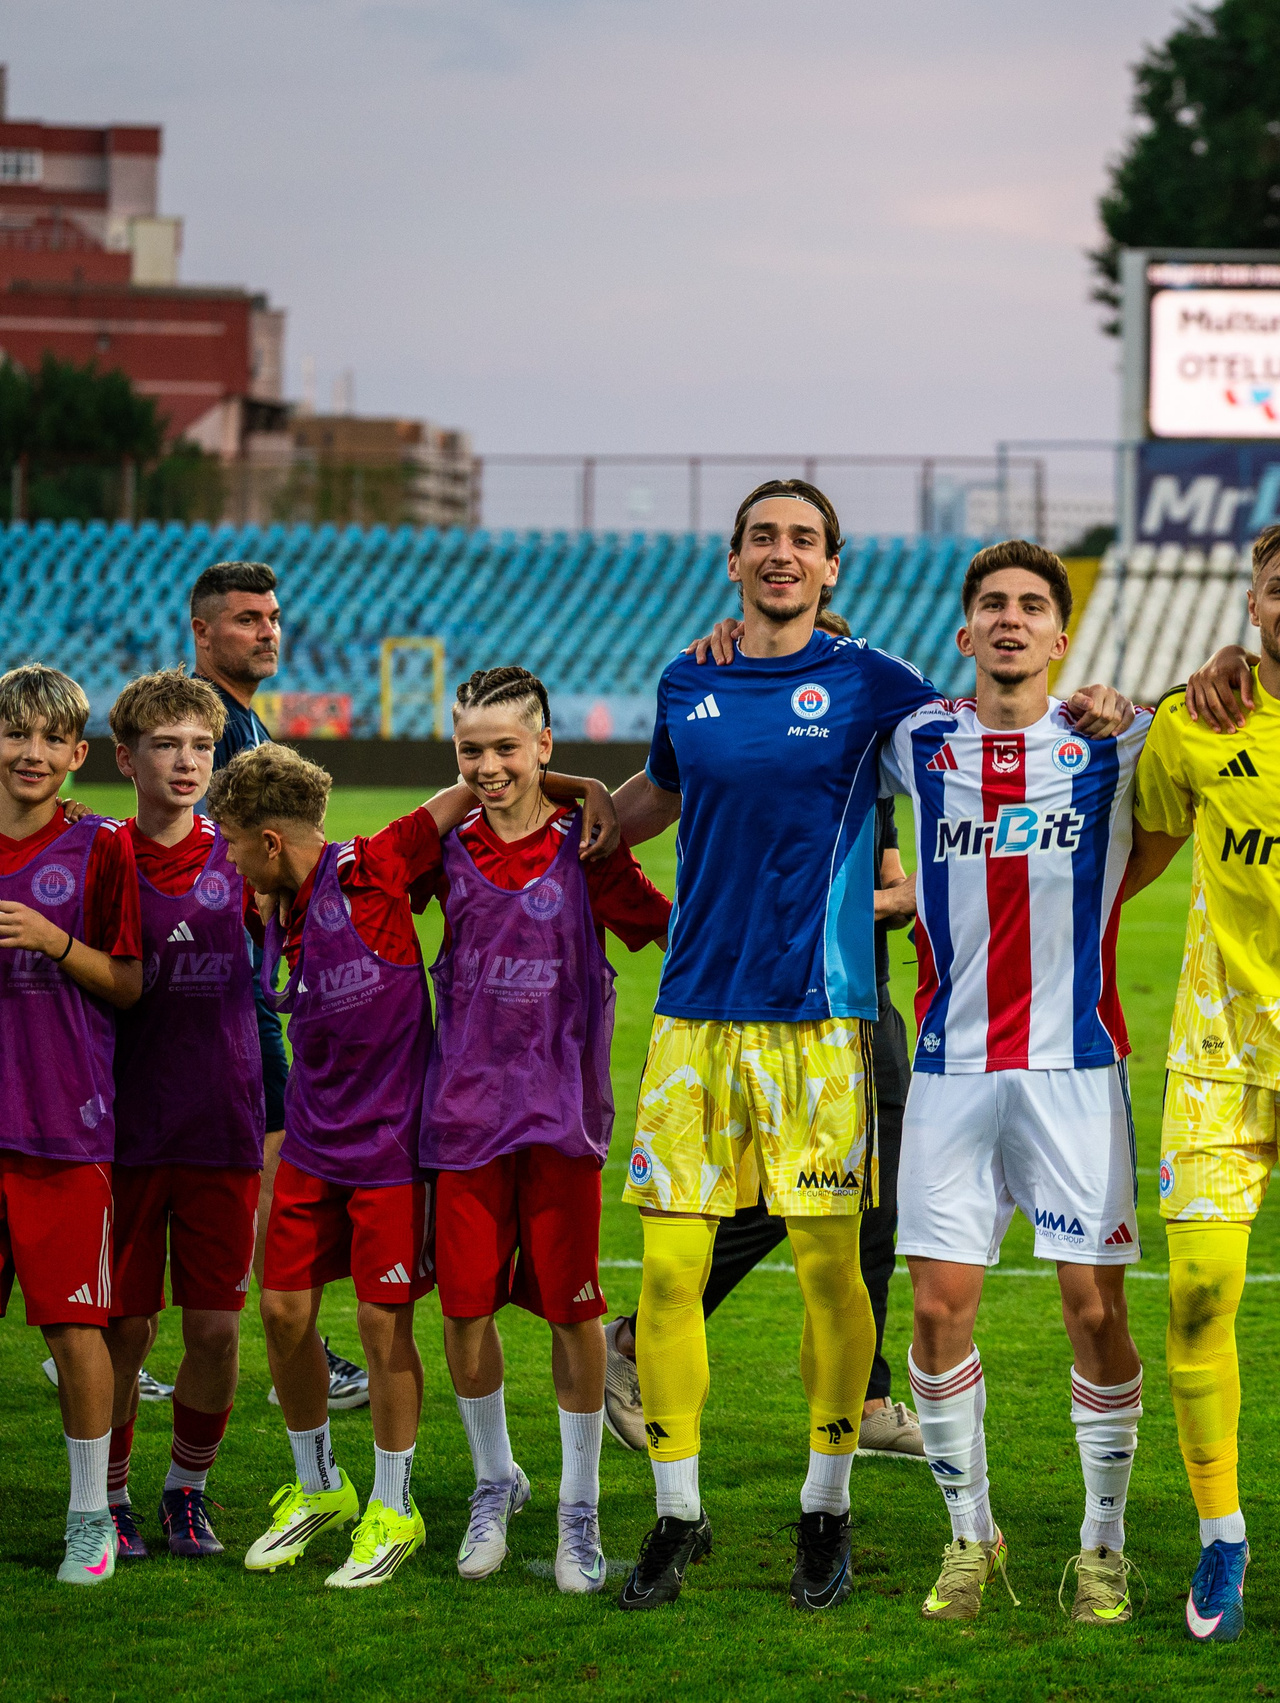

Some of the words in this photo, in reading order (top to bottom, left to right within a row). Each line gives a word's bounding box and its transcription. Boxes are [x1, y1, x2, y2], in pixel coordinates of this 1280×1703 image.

[787, 724, 830, 738] MrBit
[936, 805, 1082, 860] MrBit
[171, 952, 235, 983] IVAS
[486, 955, 564, 989] IVAS
[319, 955, 381, 1001] IVAS
[321, 995, 359, 1011] COMPLEX
[360, 984, 385, 999] AUTO
[482, 987, 526, 997] COMPLEX
[796, 1170, 860, 1189] MMA
[797, 1189, 831, 1198] SECURITY
[831, 1189, 859, 1197] GROUP
[1057, 1234, 1085, 1245] GROUP
[829, 1433, 841, 1445] 12
[944, 1488, 959, 1500] 24
[1099, 1496, 1115, 1507] 24
